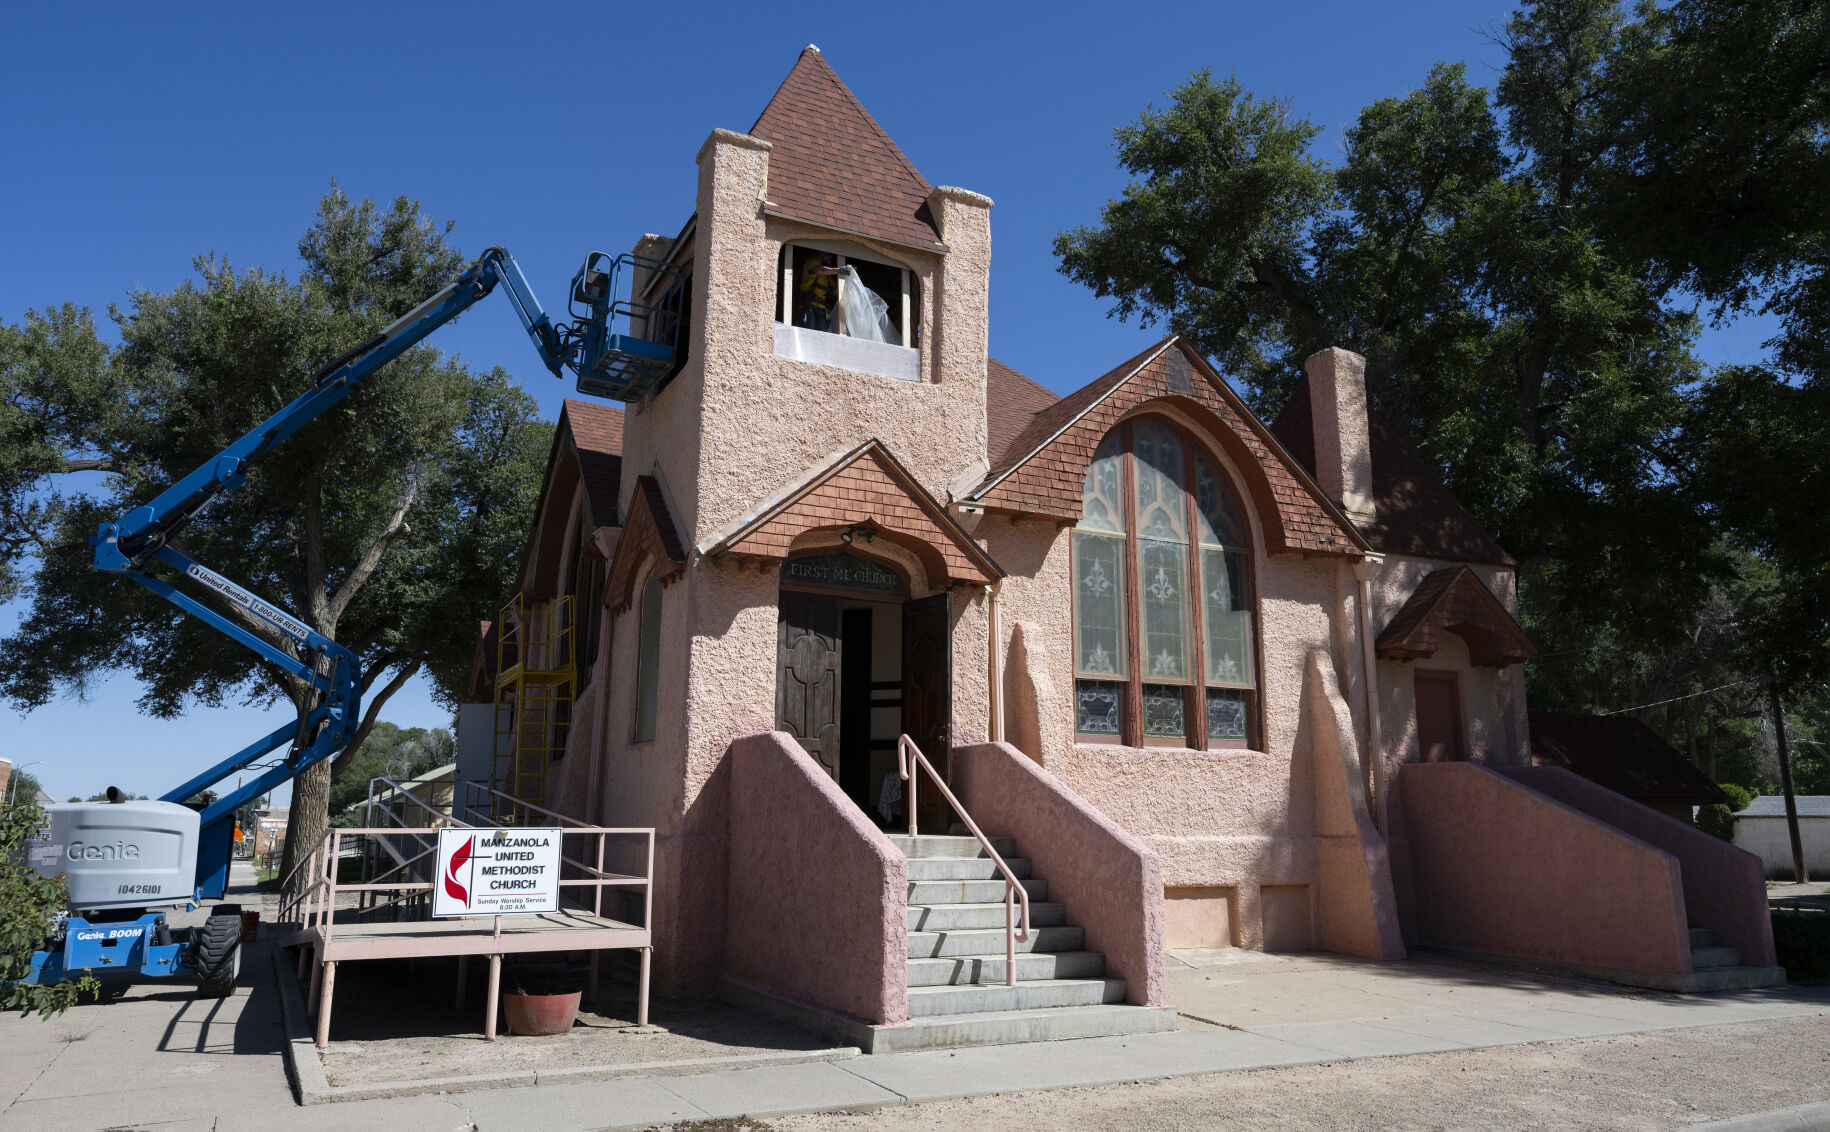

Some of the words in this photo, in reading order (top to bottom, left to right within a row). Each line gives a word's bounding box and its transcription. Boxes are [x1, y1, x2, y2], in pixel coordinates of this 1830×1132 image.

[791, 563, 830, 578] FIRST
[854, 568, 896, 585] CHURCH
[199, 572, 224, 589] United
[223, 586, 250, 604] Rentals
[254, 602, 307, 638] 1-800-UR-RENTS
[481, 838, 550, 848] MANZANOLA
[67, 840, 140, 862] Genie
[495, 852, 534, 862] UNITED
[482, 866, 546, 876] METHODIST
[118, 884, 161, 894] 10426101
[490, 880, 536, 890] CHURCH
[77, 931, 105, 940] Genie
[109, 928, 142, 938] BOOM
